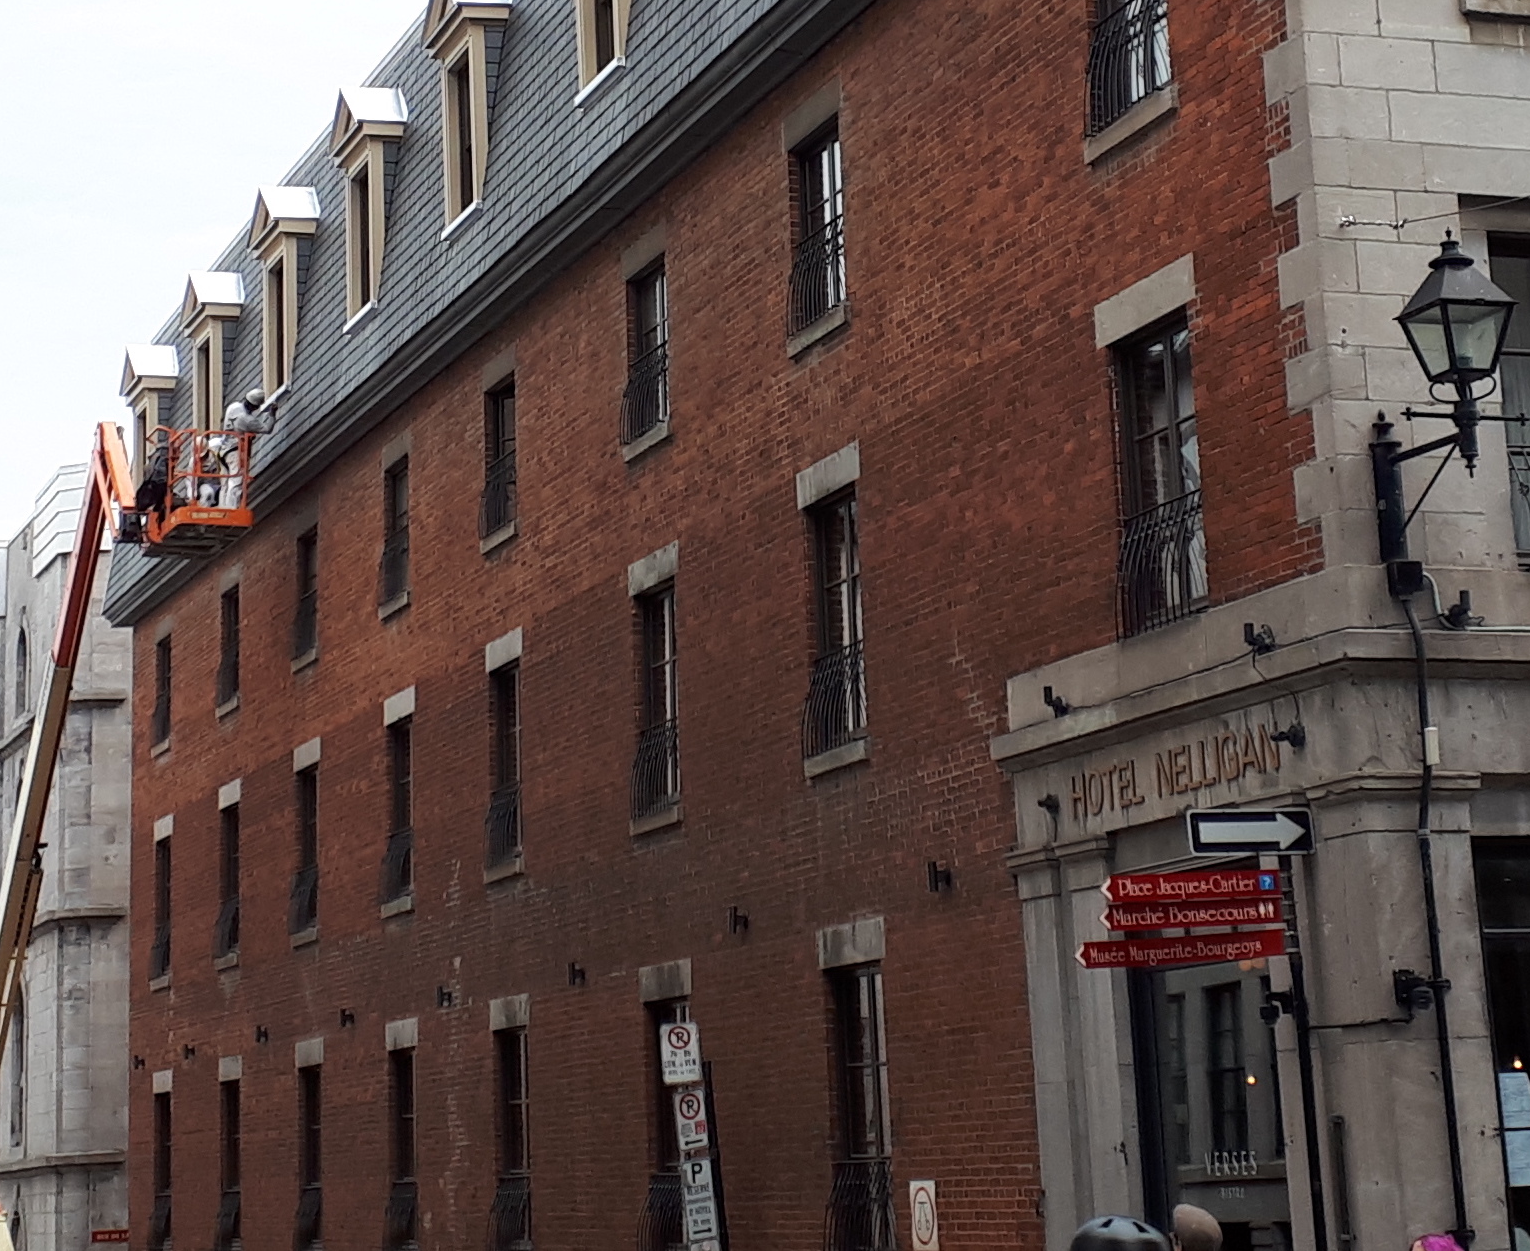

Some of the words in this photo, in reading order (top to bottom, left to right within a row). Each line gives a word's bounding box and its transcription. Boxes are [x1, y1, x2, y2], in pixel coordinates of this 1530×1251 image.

[1072, 758, 1145, 820] HOTEL
[1155, 722, 1281, 799] NELLIGAN
[1118, 878, 1153, 897] Place
[1157, 875, 1255, 899] Jacques-Cartier
[1112, 906, 1165, 926] Marché
[1170, 906, 1258, 925] Bonsecours
[1090, 946, 1126, 964] Musée
[1130, 939, 1263, 966] Marguerite-Bourgeoys
[1204, 1150, 1258, 1177] VERSES
